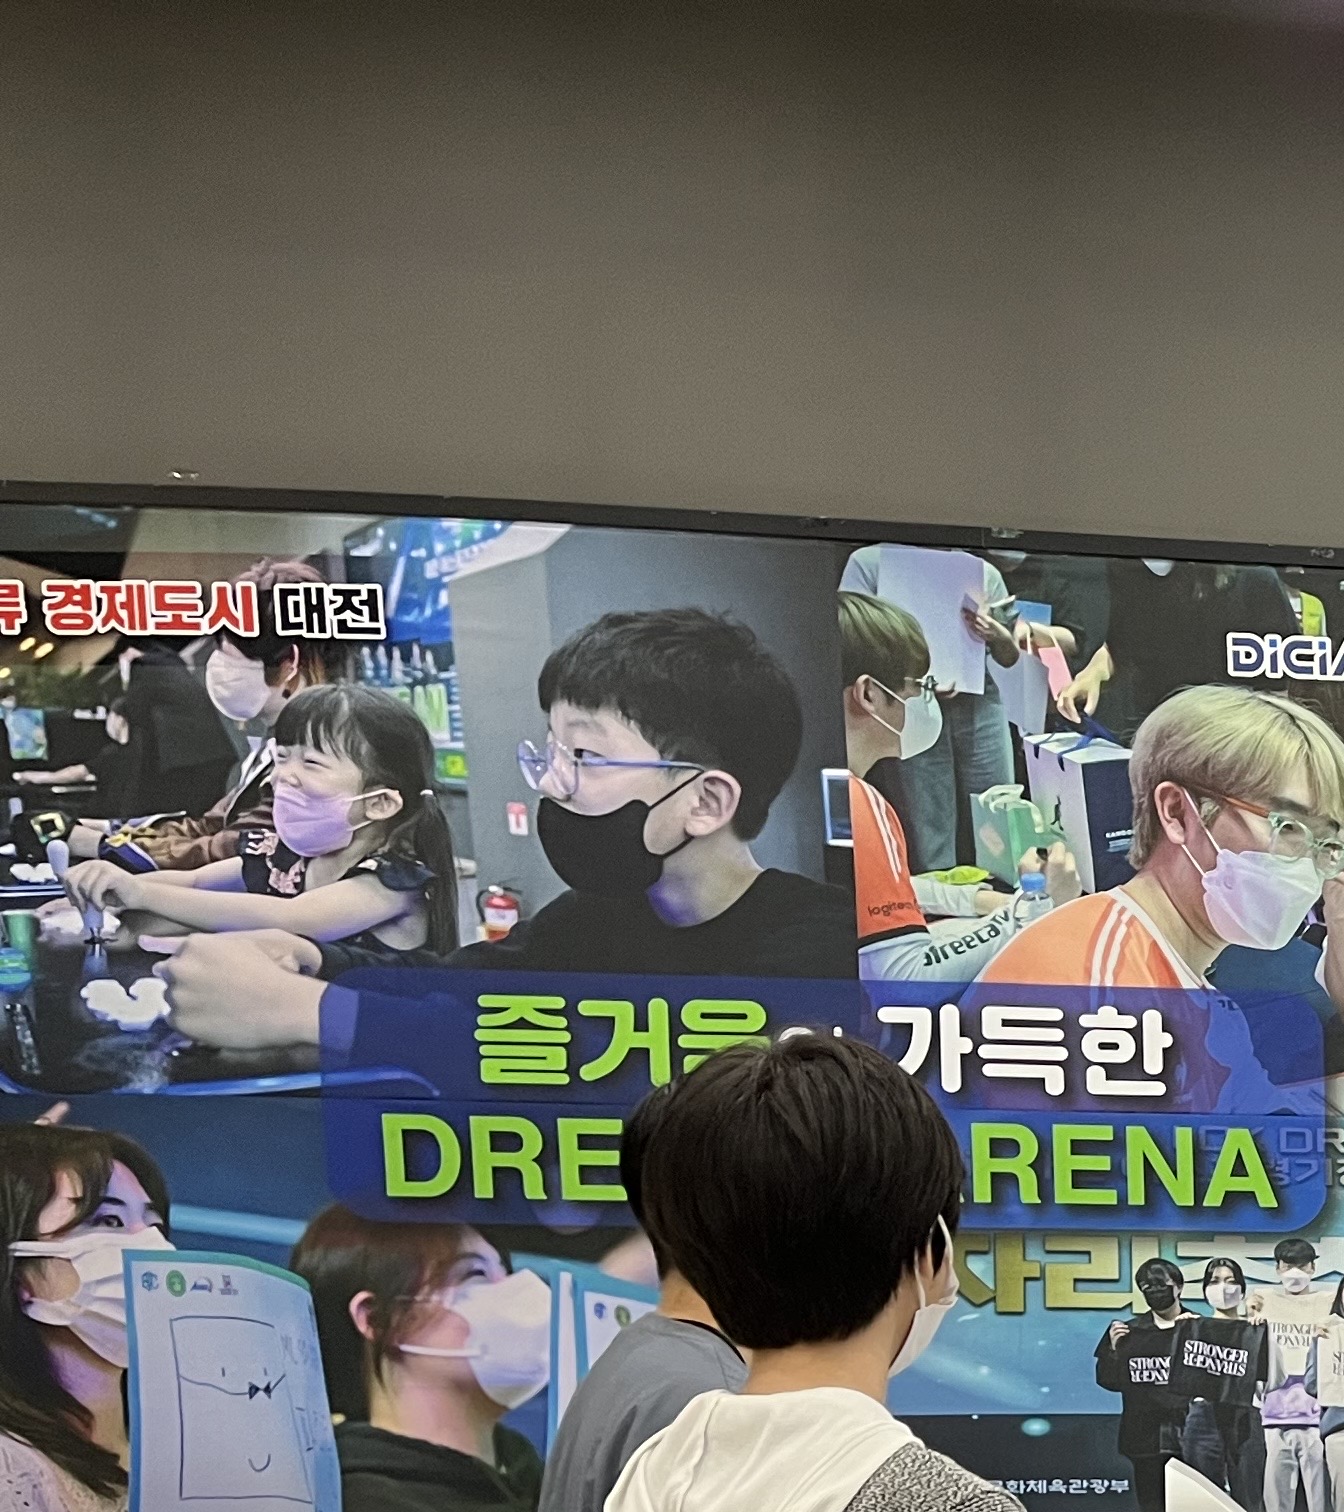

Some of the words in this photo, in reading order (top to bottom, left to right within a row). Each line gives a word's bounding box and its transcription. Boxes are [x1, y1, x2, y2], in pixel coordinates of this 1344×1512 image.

[46, 583, 256, 633] 경제도시
[278, 587, 385, 636] 대전
[877, 1003, 1174, 1097] 가득한
[960, 1122, 1278, 1208] RENA
